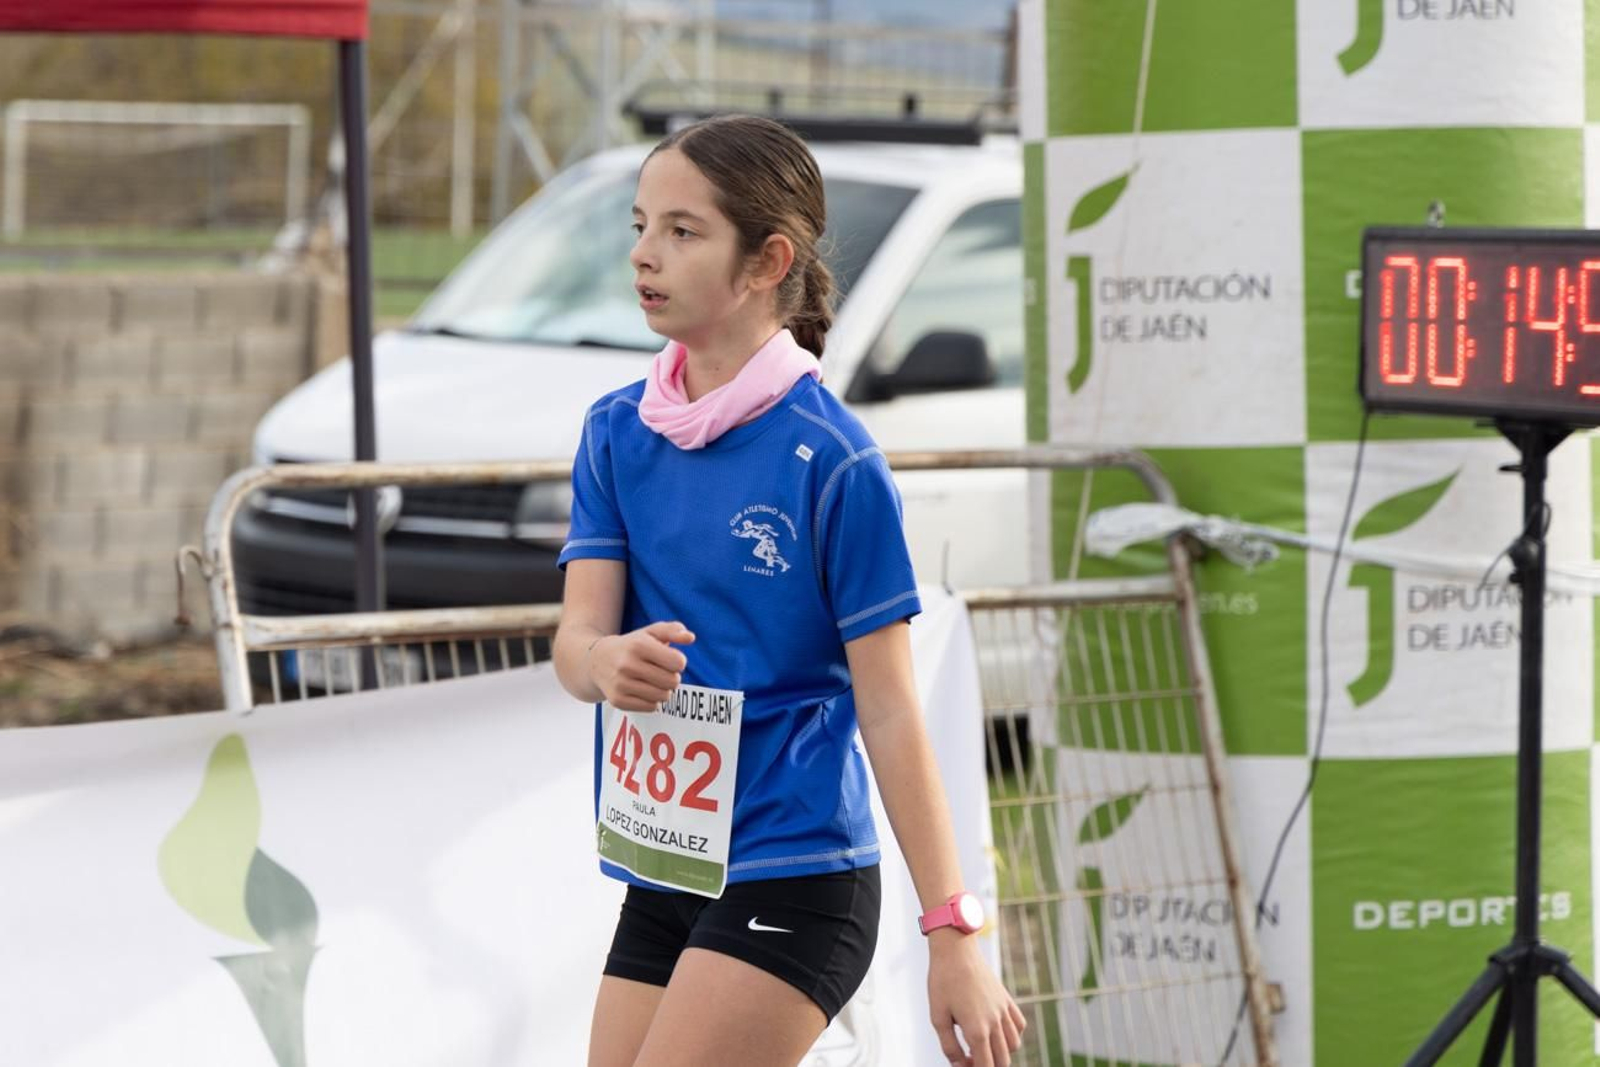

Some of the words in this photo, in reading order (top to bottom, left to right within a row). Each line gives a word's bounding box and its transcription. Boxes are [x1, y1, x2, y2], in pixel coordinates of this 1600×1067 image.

[1100, 269, 1271, 305] DIPUTACIÓN
[1100, 315, 1133, 343] DE
[1139, 309, 1208, 342] JAÉN
[743, 504, 778, 516] ATLETISMO
[743, 564, 775, 577] LINARES
[1407, 624, 1449, 651] DE
[690, 691, 705, 721] DE
[706, 694, 733, 725] JAEN
[609, 715, 722, 813] 4282
[632, 800, 656, 816] PAULA
[606, 804, 631, 832] LOPEZ
[633, 820, 708, 853] GONZALEZ
